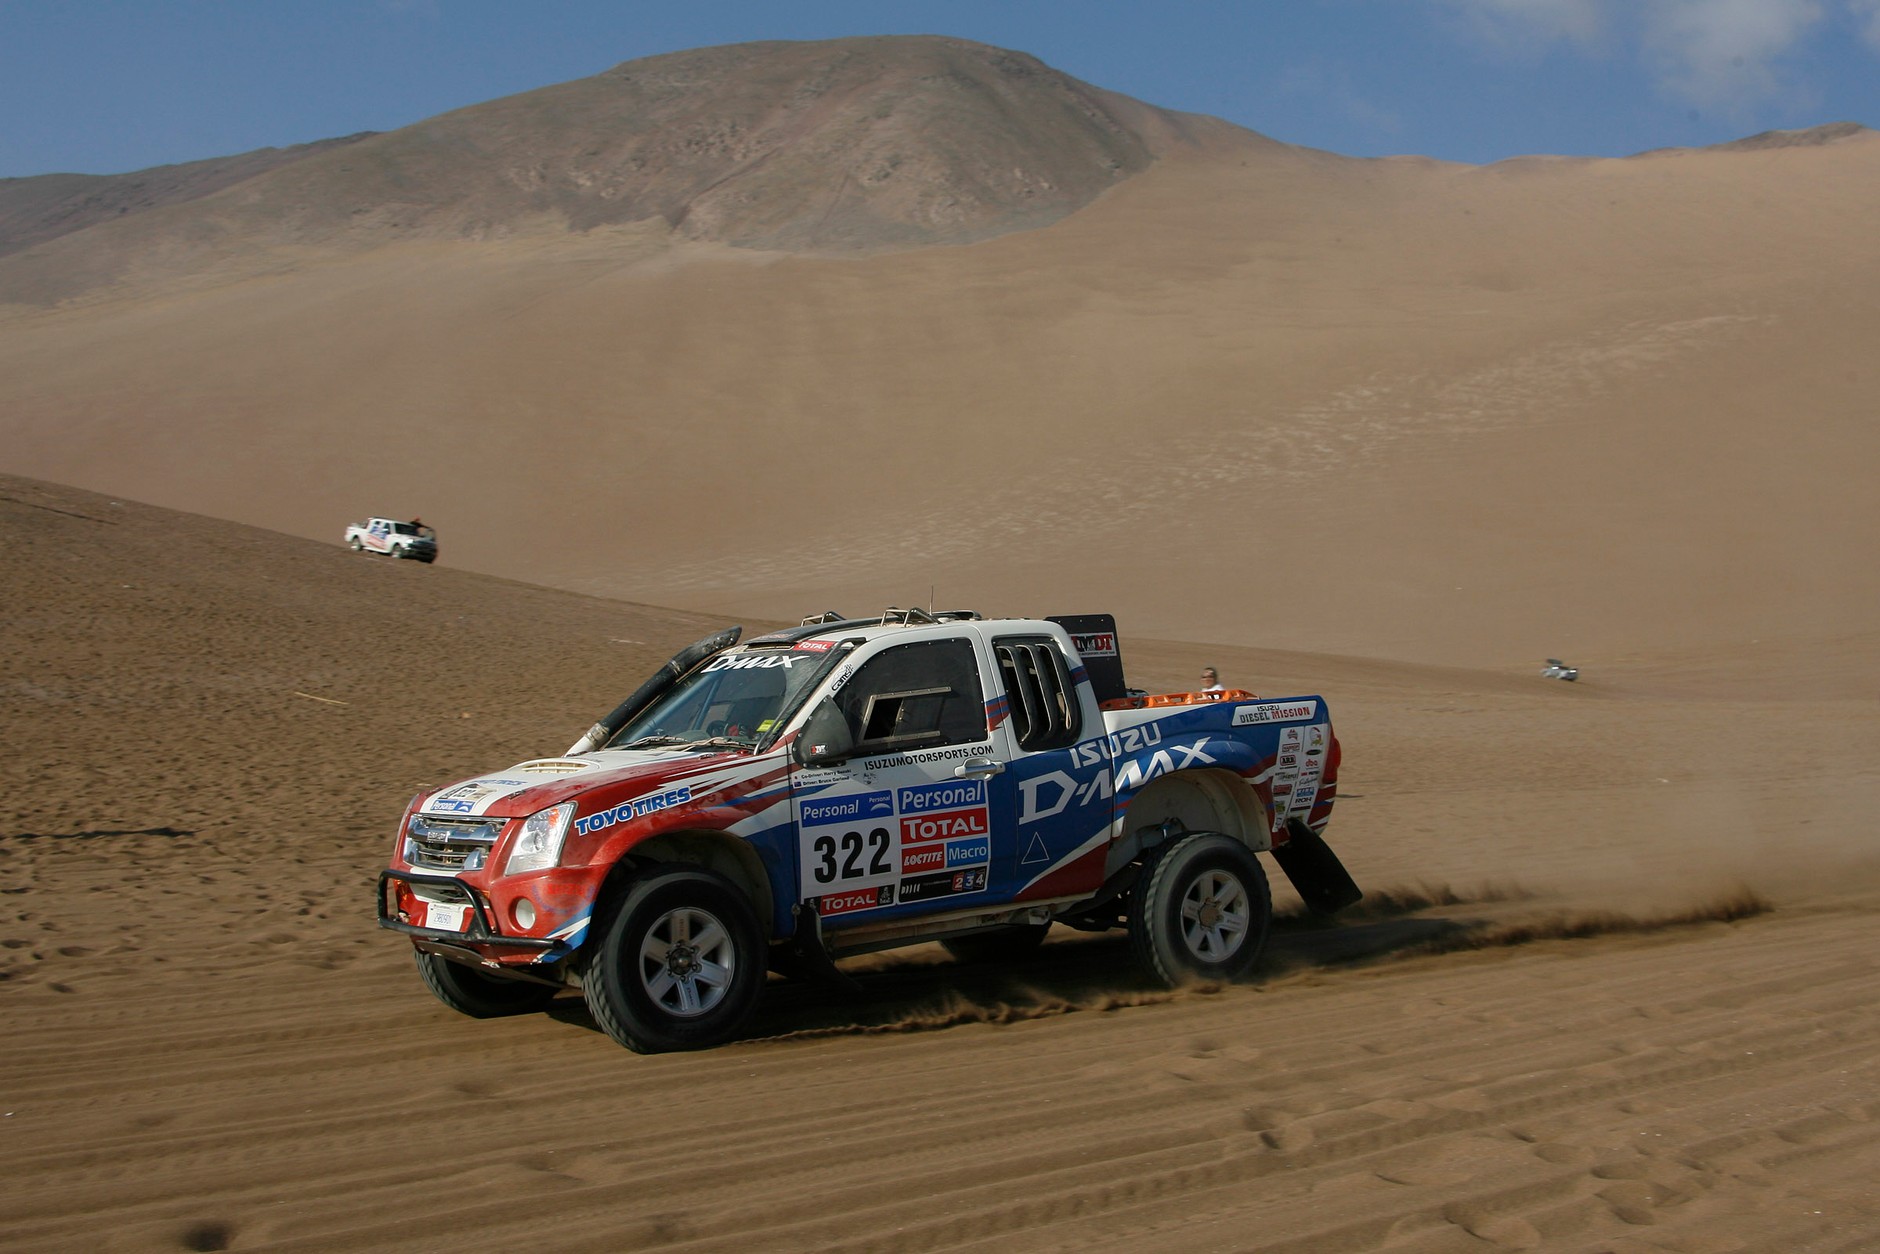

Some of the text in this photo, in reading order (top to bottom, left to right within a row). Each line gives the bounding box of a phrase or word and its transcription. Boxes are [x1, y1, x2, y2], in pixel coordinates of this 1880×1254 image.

[798, 641, 828, 650] TOTAL
[1239, 706, 1310, 723] DIESEL MISSION
[1257, 704, 1280, 712] ISUZU
[1069, 722, 1162, 769] ISUZU
[864, 745, 994, 771] ISUZUMOTORSPORTS.COM
[868, 795, 891, 803] Personal
[902, 780, 982, 810] Personal
[575, 786, 692, 836] TOYO TIRES
[803, 800, 859, 820] Personal
[903, 816, 985, 840] TOTAL
[813, 827, 891, 883] 322
[903, 851, 943, 866] LOCTITE
[948, 846, 987, 861] Macro
[955, 877, 963, 888] 2
[966, 875, 974, 886] 3
[976, 873, 985, 885] 4
[822, 894, 876, 910] TOTAL
